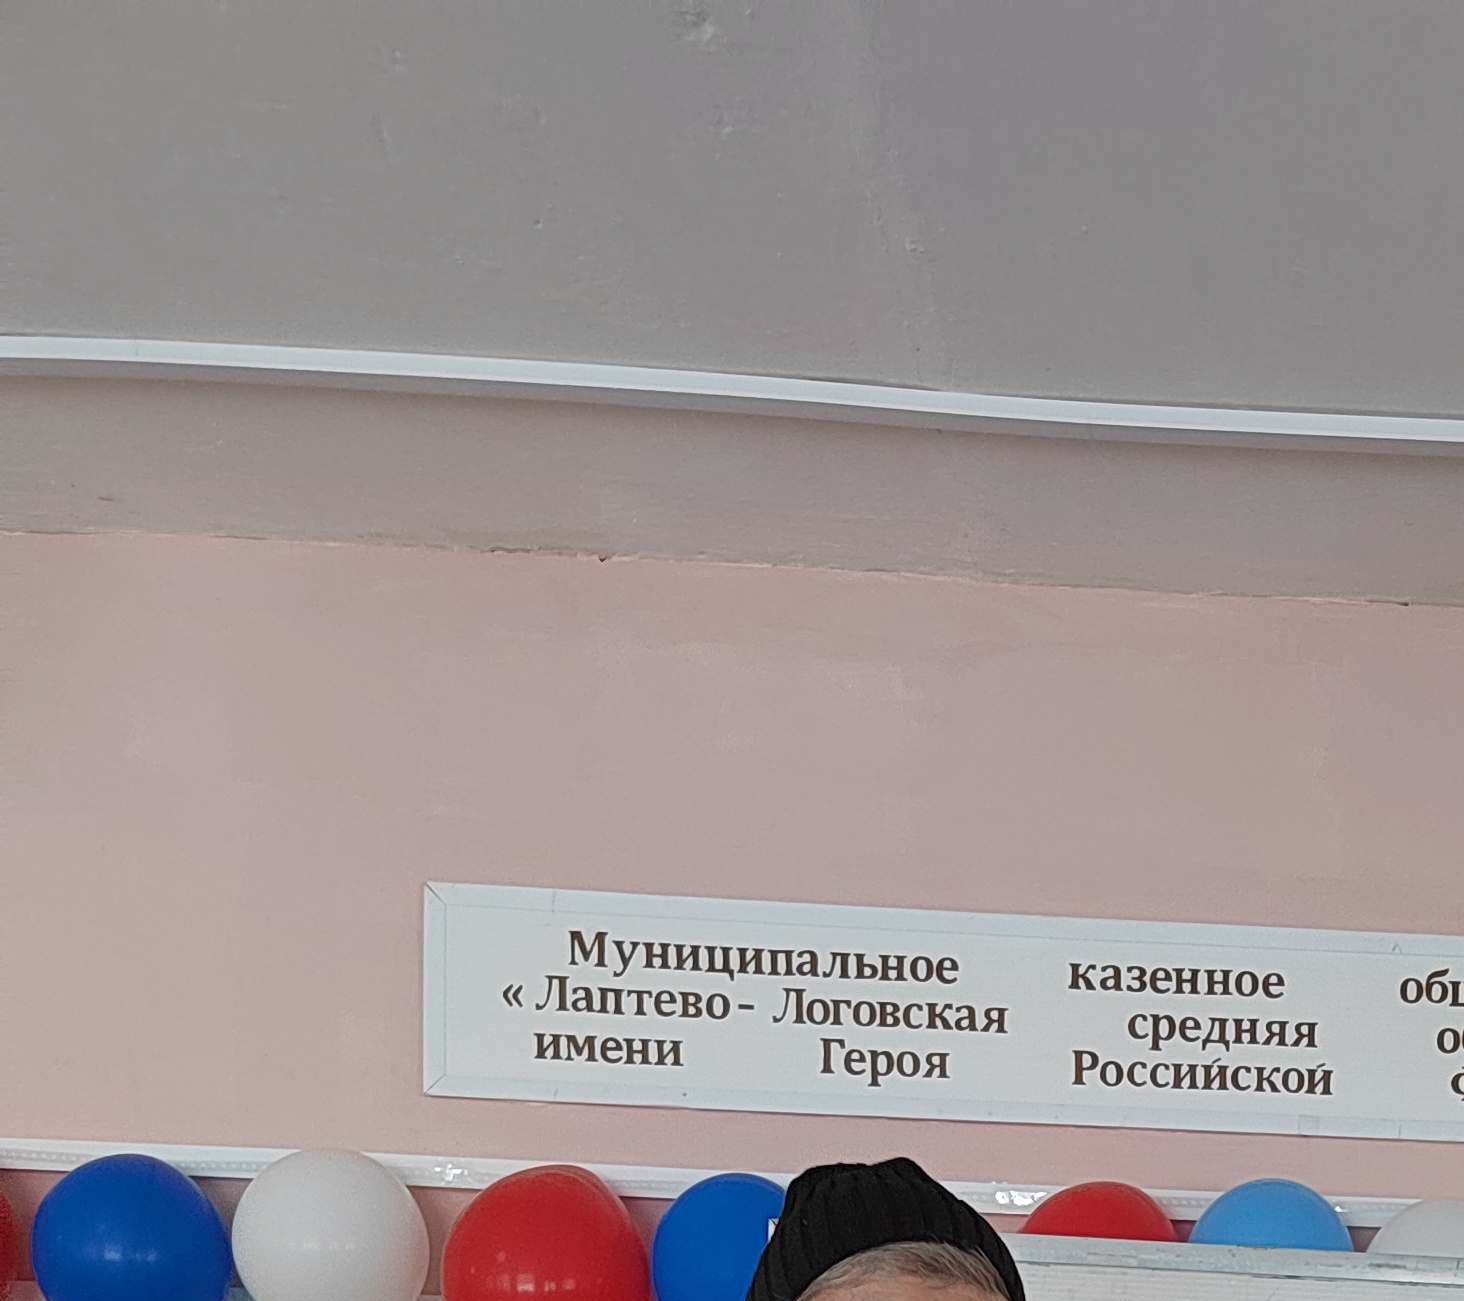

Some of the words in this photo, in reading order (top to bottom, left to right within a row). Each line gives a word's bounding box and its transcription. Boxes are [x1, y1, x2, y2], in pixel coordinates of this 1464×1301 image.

[568, 929, 959, 985] Муниципальное
[1067, 960, 1286, 999] казенное
[772, 988, 1009, 1034] Логовская
[1127, 1009, 1319, 1050] средняя
[534, 1033, 685, 1067] имени
[819, 1037, 951, 1087] Героя
[1072, 1049, 1334, 1097] Российской
